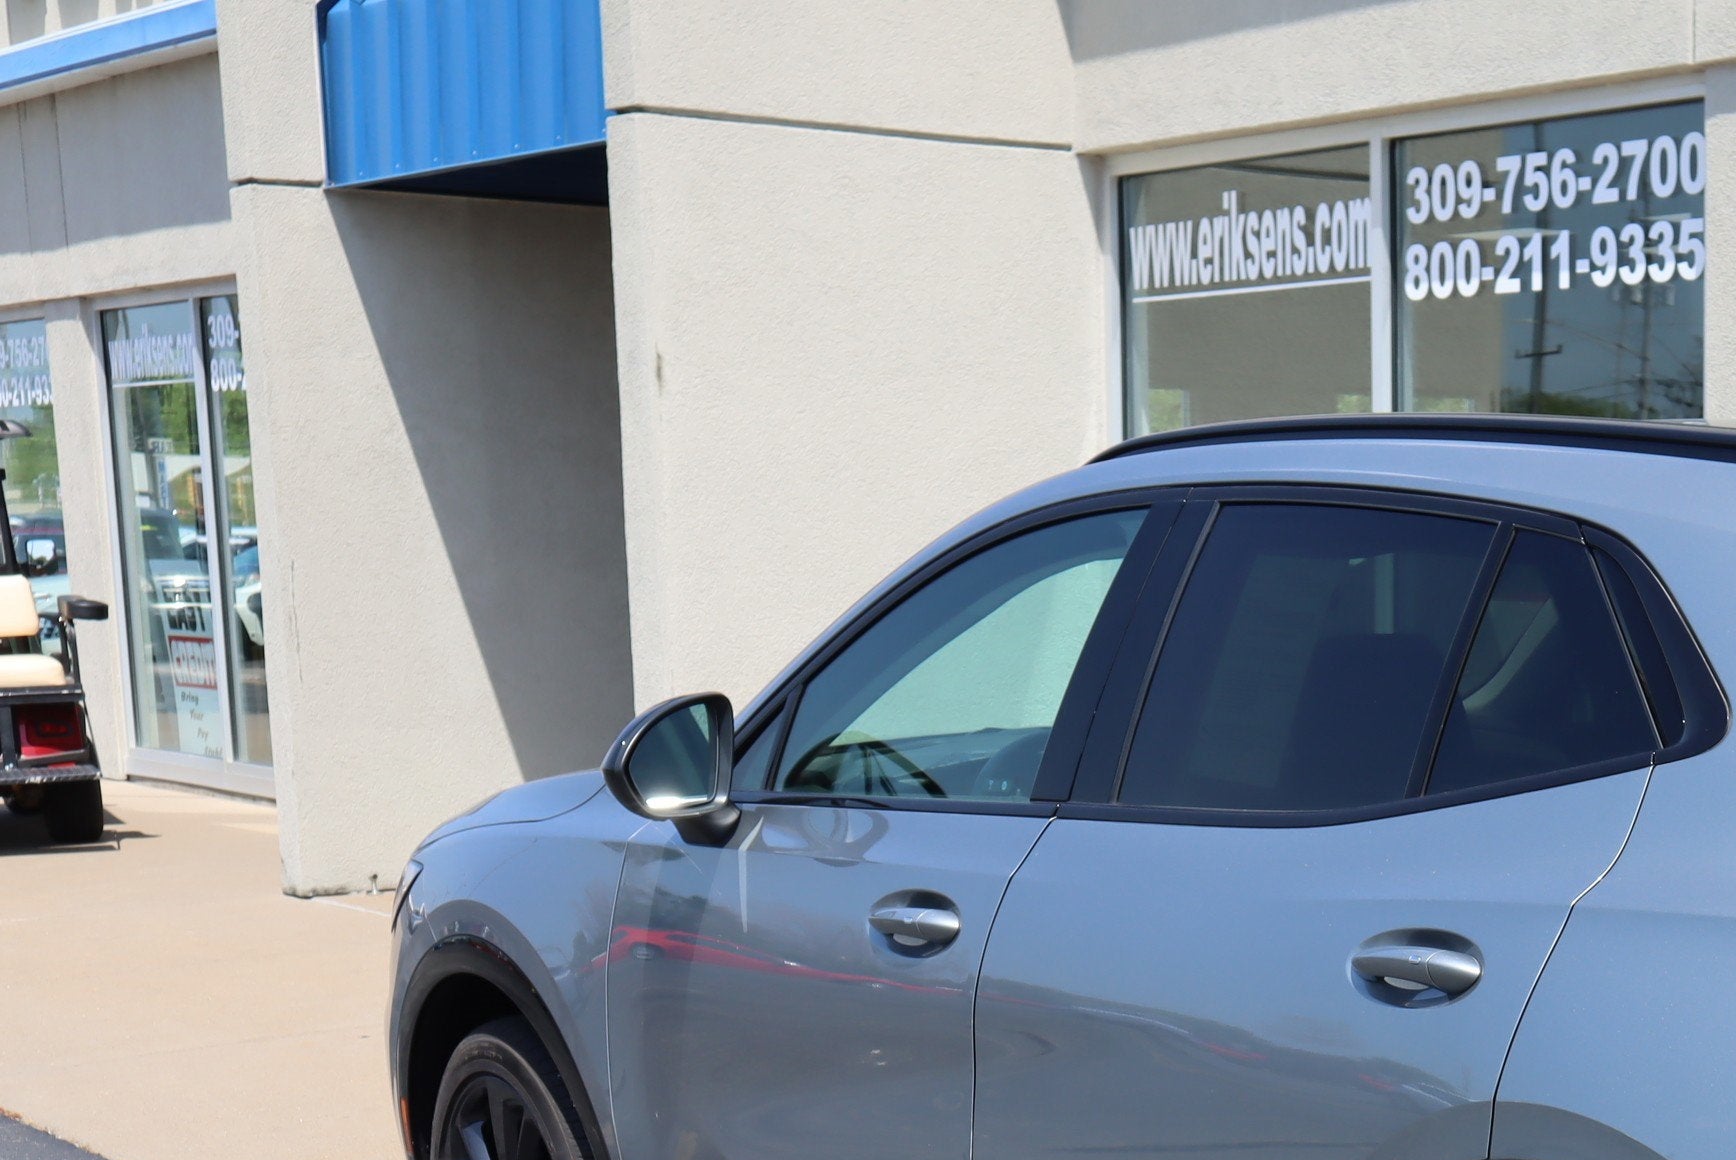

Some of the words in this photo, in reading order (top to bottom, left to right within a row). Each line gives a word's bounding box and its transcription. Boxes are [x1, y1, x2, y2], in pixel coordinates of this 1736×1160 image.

[1406, 131, 1706, 225] 309-756-2700
[1129, 190, 1371, 290] www.eriksens.com
[1404, 218, 1706, 302] 800-211-9335
